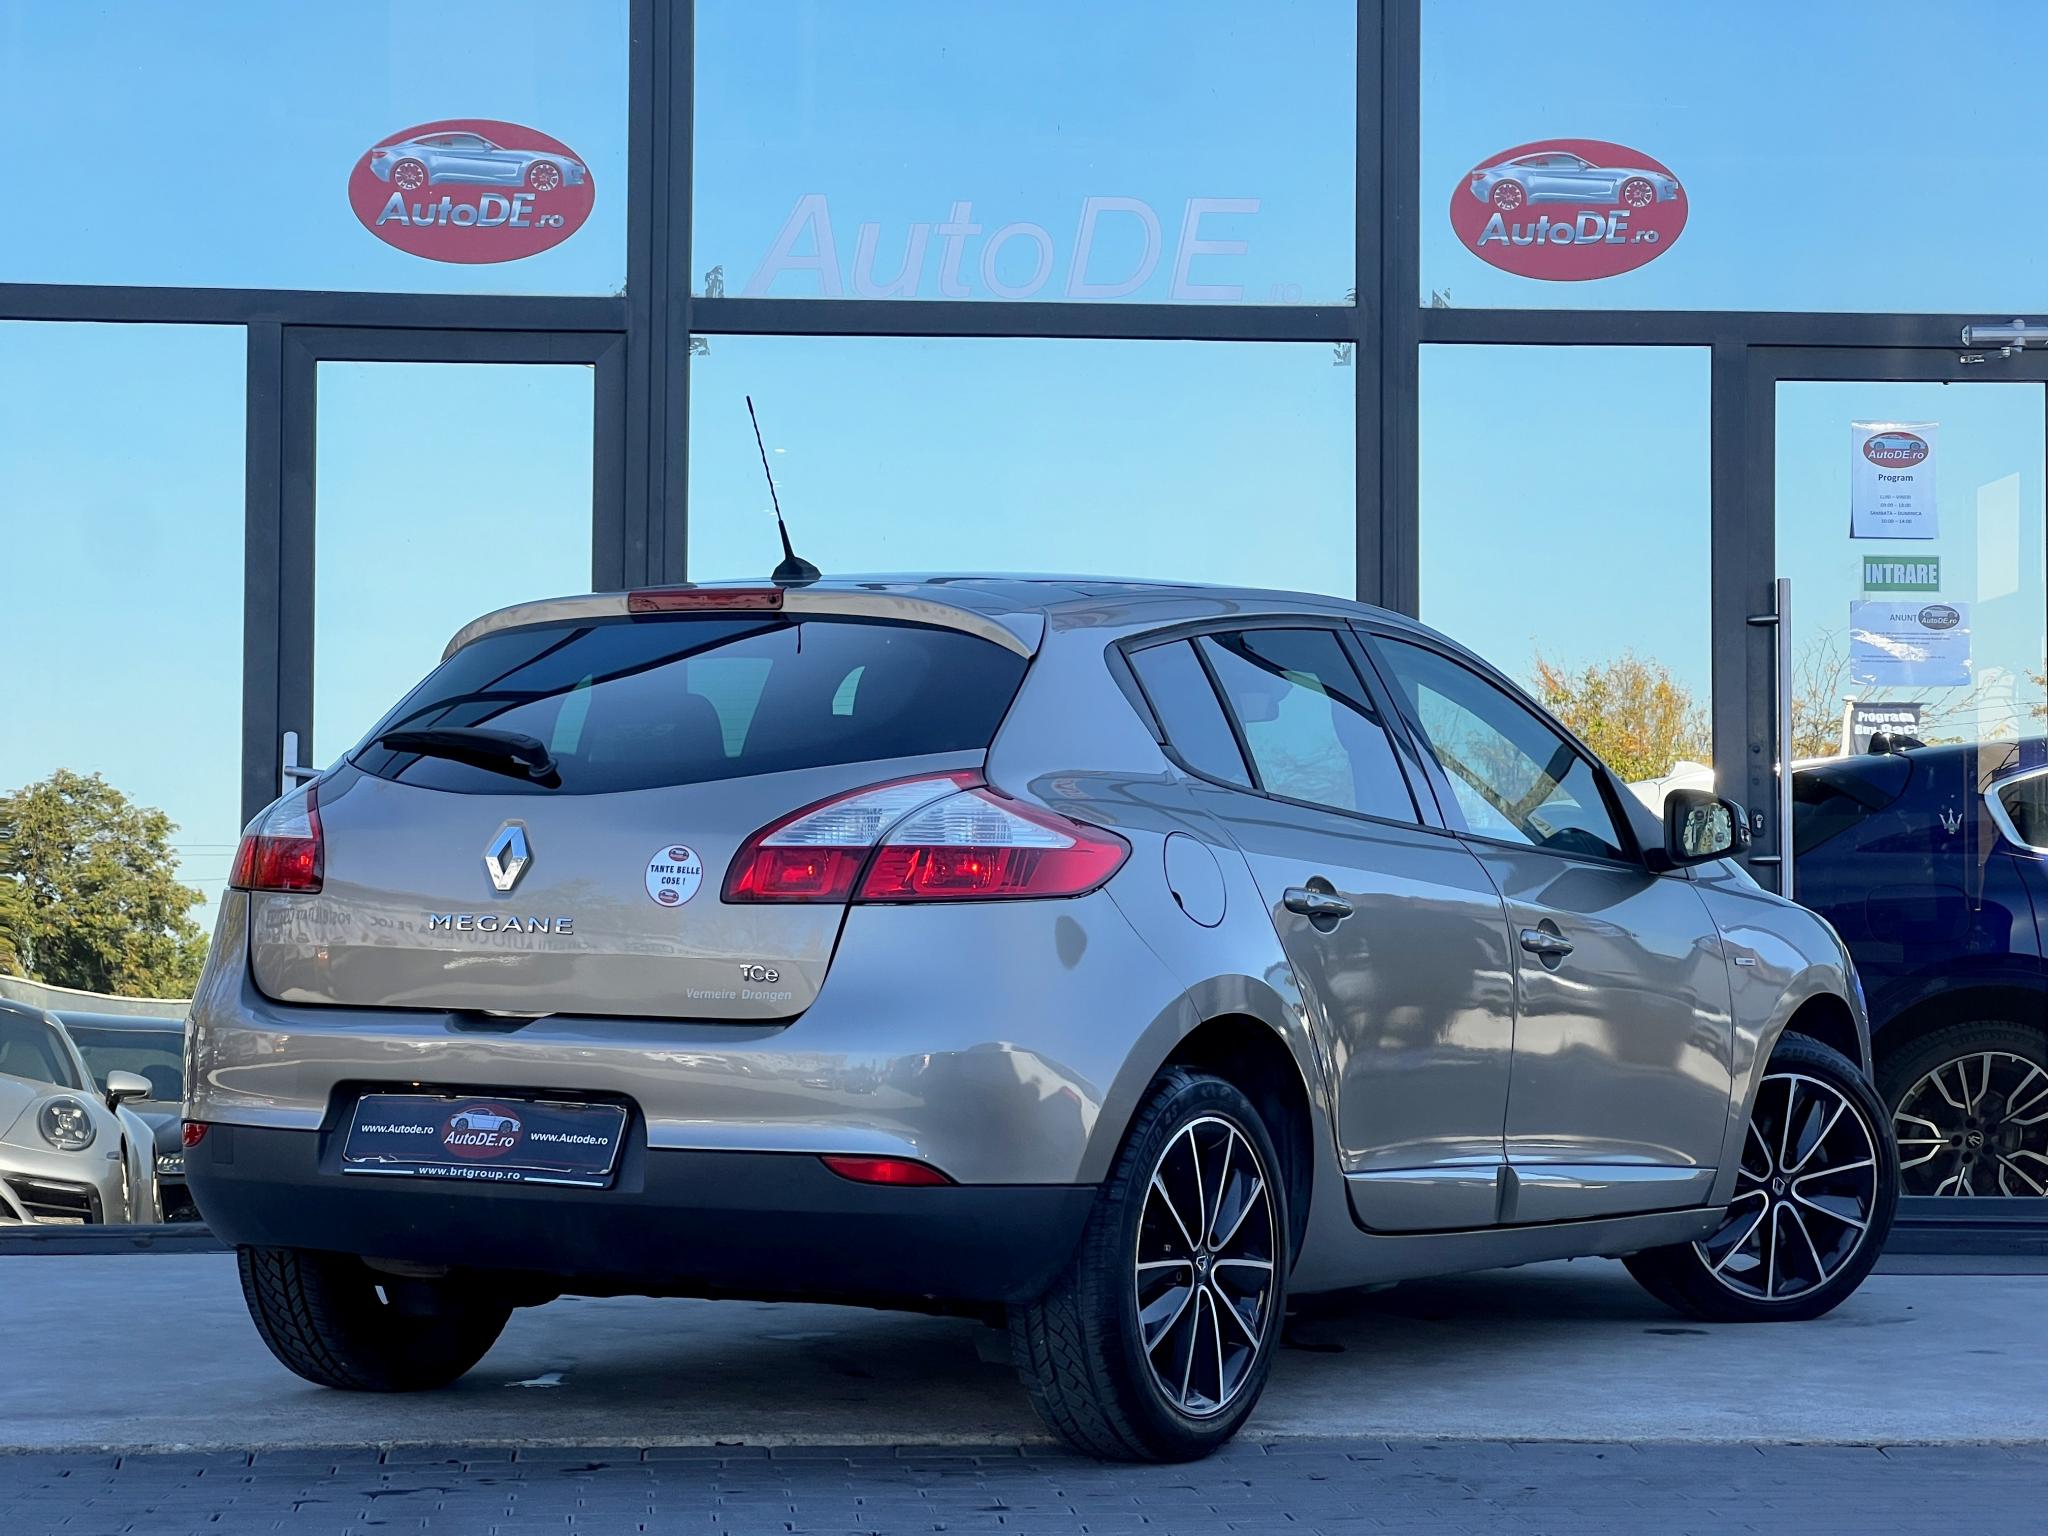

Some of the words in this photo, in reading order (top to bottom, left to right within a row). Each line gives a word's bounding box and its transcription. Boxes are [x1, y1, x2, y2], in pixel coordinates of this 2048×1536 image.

[1868, 450, 1925, 460] AutoDE.ro
[1878, 473, 1914, 483] Program
[1866, 563, 1938, 585] INTRARE
[1858, 712, 1916, 723] Program
[651, 864, 675, 873] TANTE
[676, 866, 701, 875] BELLE
[661, 876, 681, 885] COSE
[429, 913, 574, 936] MEGANE
[740, 963, 779, 983] TCe
[686, 987, 736, 1000] Vermeire
[742, 988, 792, 1002] Drongen
[361, 1122, 434, 1135] www.Autode.ro
[444, 1131, 515, 1149] AutoDE.ro
[530, 1131, 608, 1146] www.Autode.ro
[418, 1165, 521, 1181] www.brtgroup.ro
